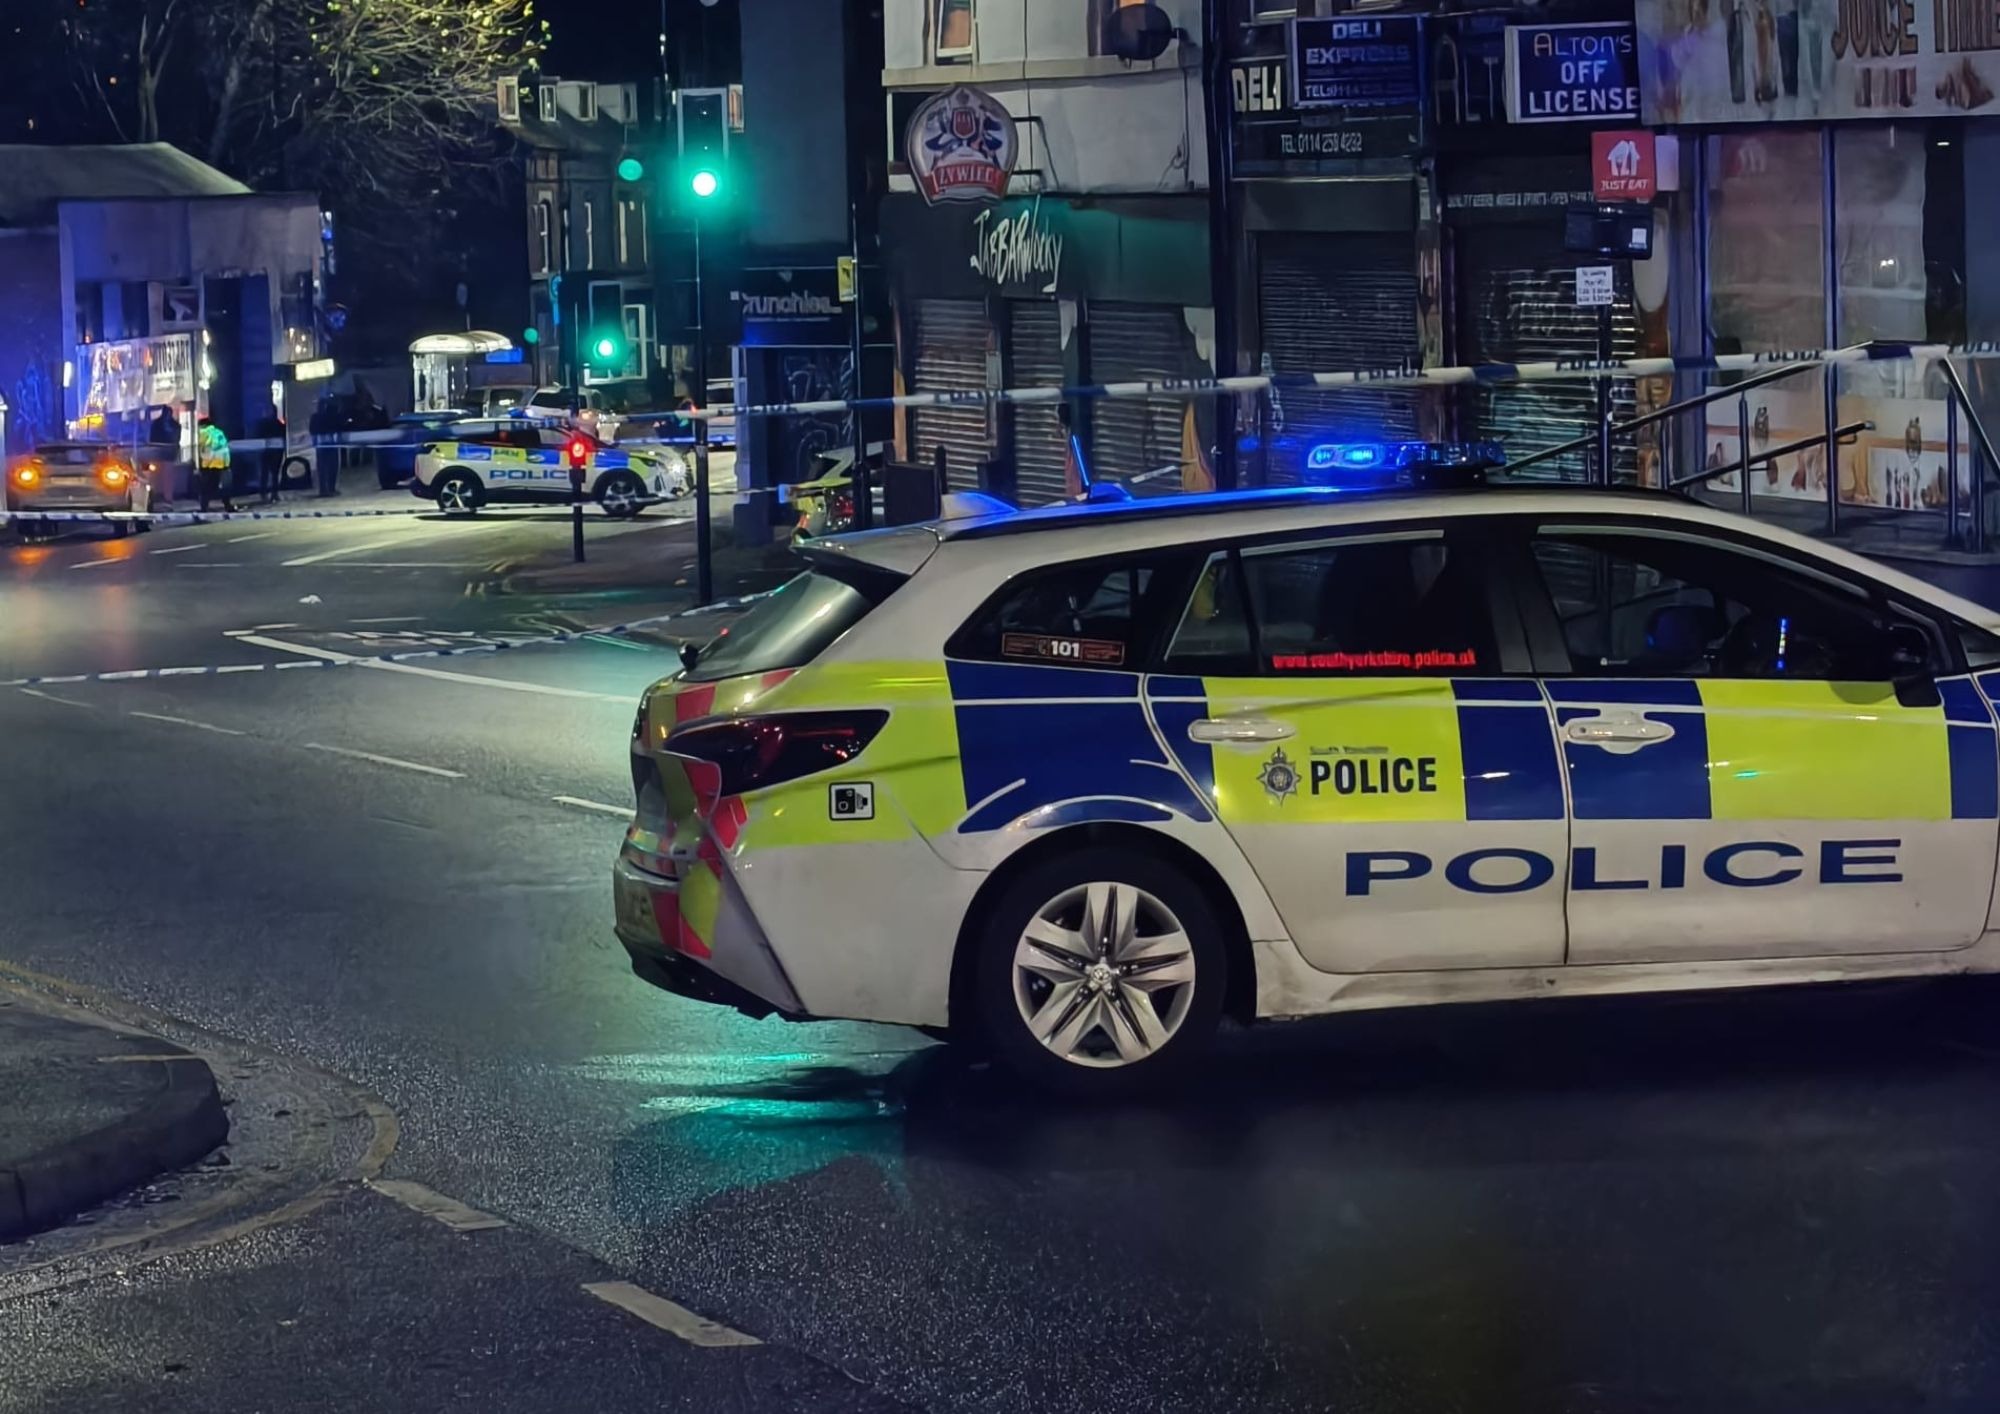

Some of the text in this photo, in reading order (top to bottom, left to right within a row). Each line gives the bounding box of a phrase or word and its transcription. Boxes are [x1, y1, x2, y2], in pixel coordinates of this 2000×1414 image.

[1333, 21, 1381, 39] DELI
[1831, 0, 1918, 59] JUICE
[1561, 60, 1607, 84] OFF
[1232, 66, 1281, 113] DELI
[1529, 87, 1640, 114] LICENSE
[1601, 179, 1648, 191] JUST EAT
[489, 470, 569, 480] POLIC
[1052, 641, 1080, 657] 101
[1311, 757, 1437, 795] POLICE
[1345, 839, 1903, 896] POLICE
